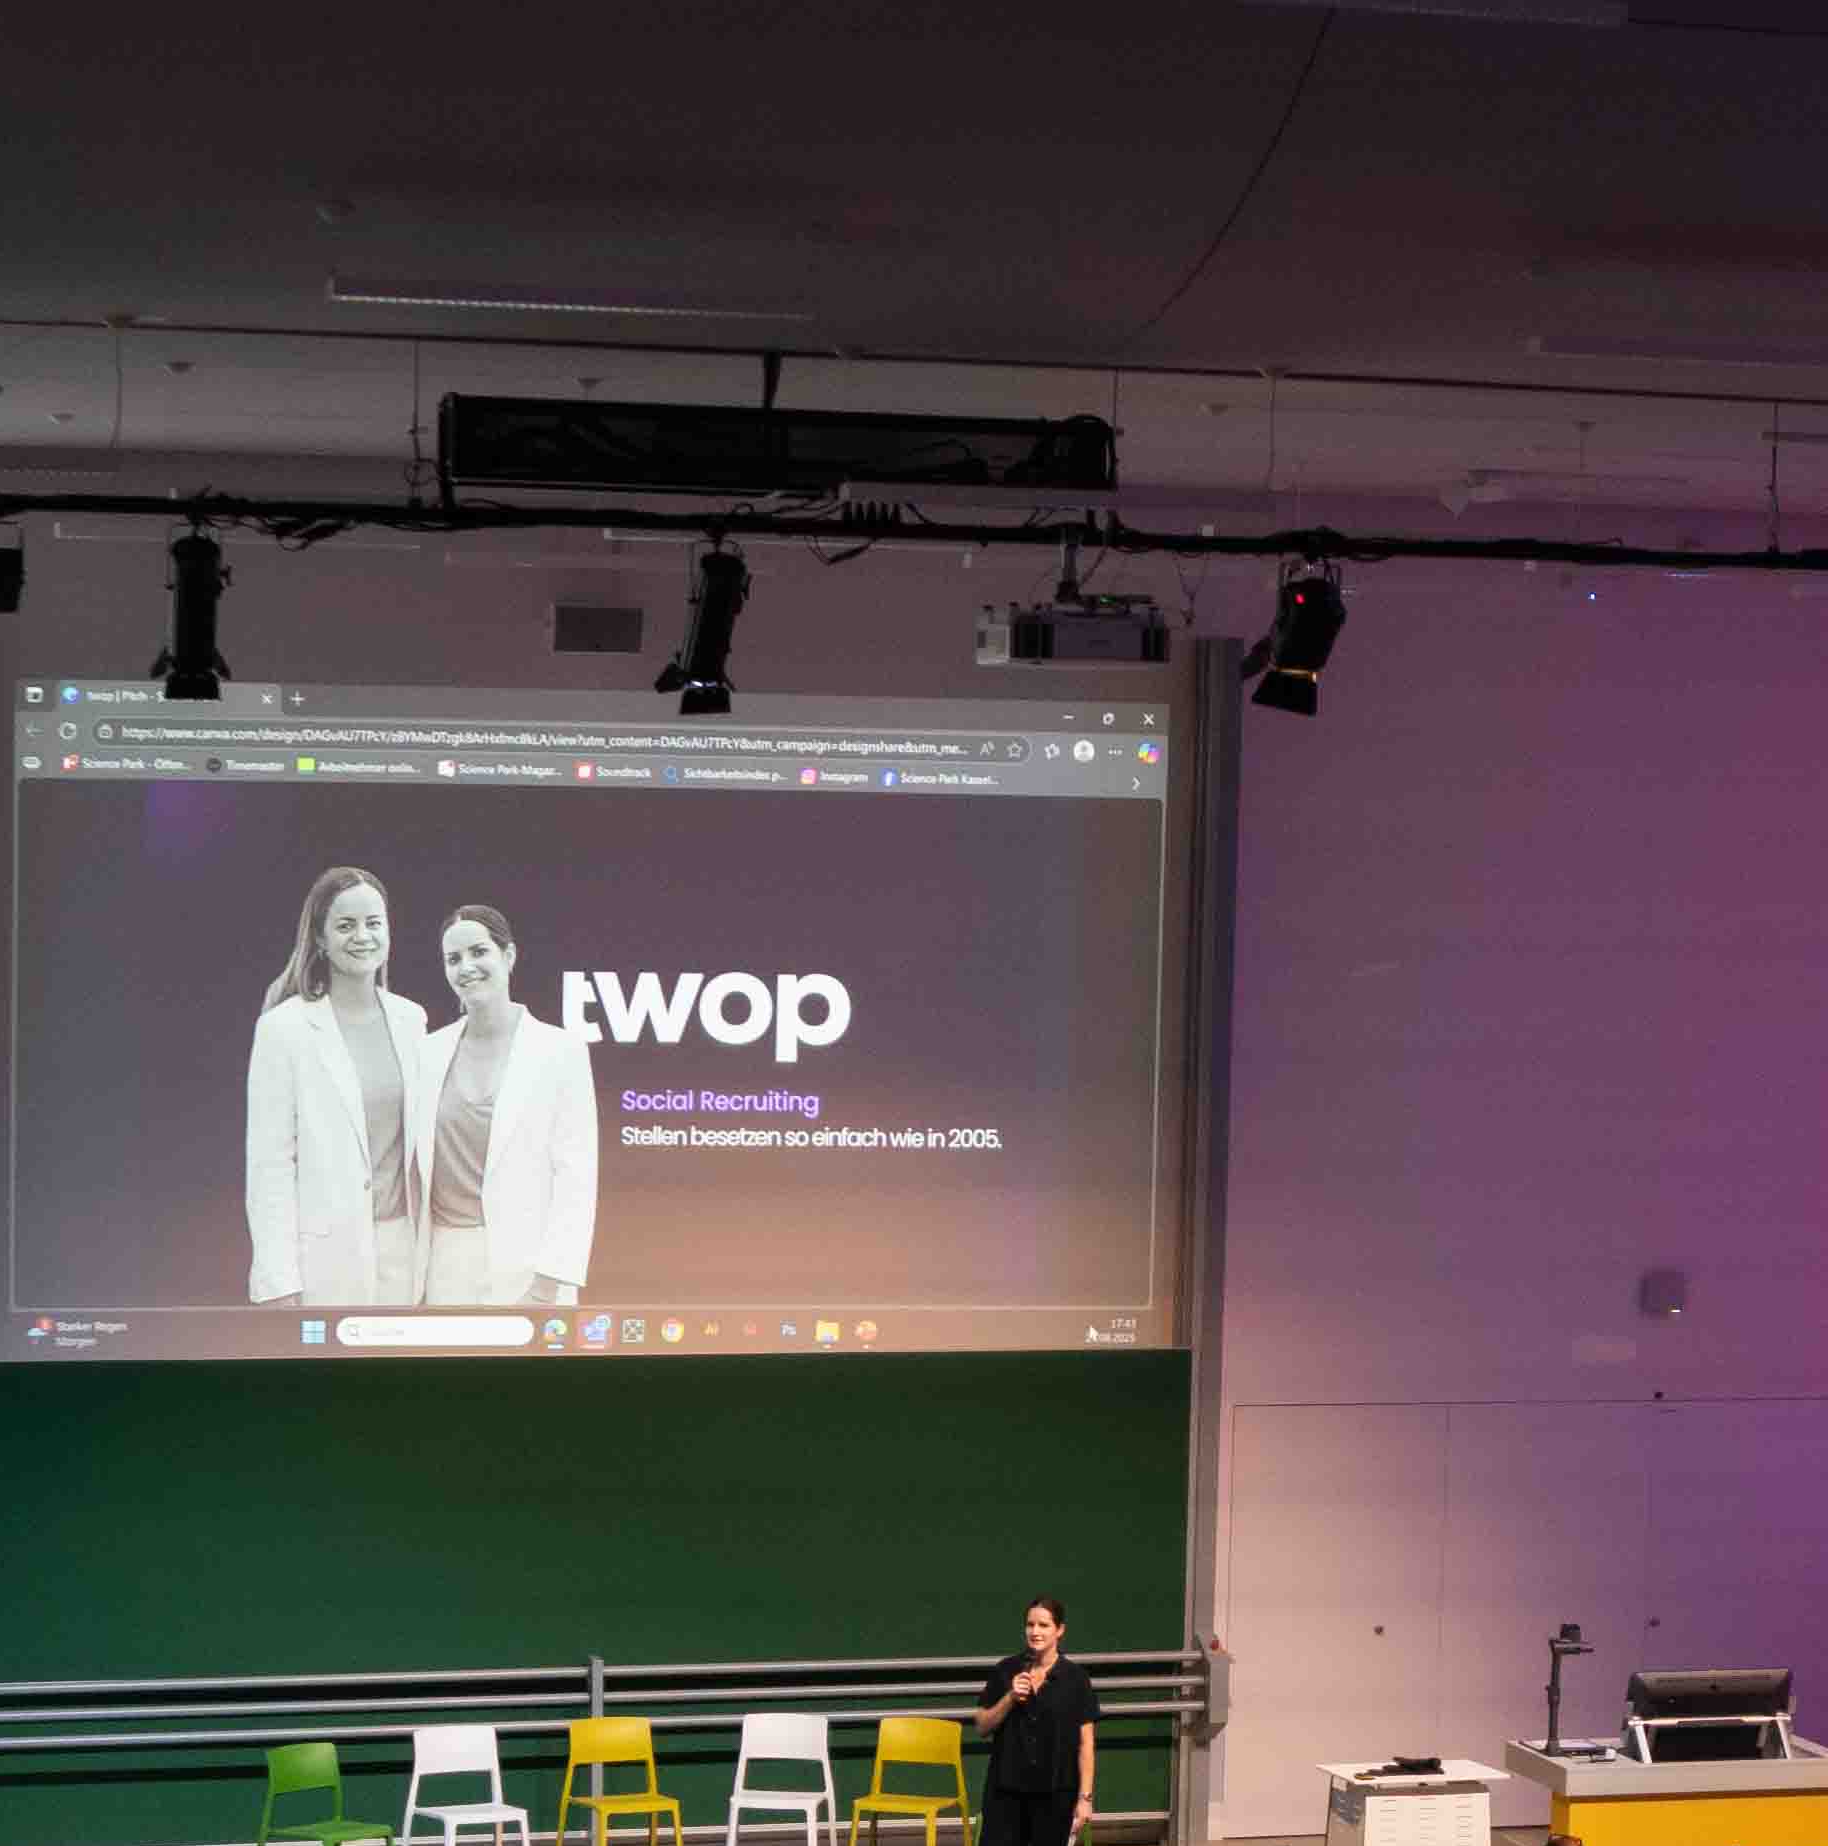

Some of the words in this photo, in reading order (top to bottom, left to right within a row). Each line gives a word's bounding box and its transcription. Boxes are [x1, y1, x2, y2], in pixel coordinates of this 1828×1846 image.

[562, 971, 852, 1063] twop
[622, 1090, 693, 1112] Social
[701, 1090, 820, 1119] Recruiting
[621, 1126, 688, 1147] Stellen
[690, 1127, 781, 1148] besetzen
[785, 1133, 809, 1148] so
[812, 1127, 887, 1149] einfach
[890, 1130, 924, 1148] wie
[928, 1130, 945, 1148] in
[948, 1129, 1002, 1149] 2005.
